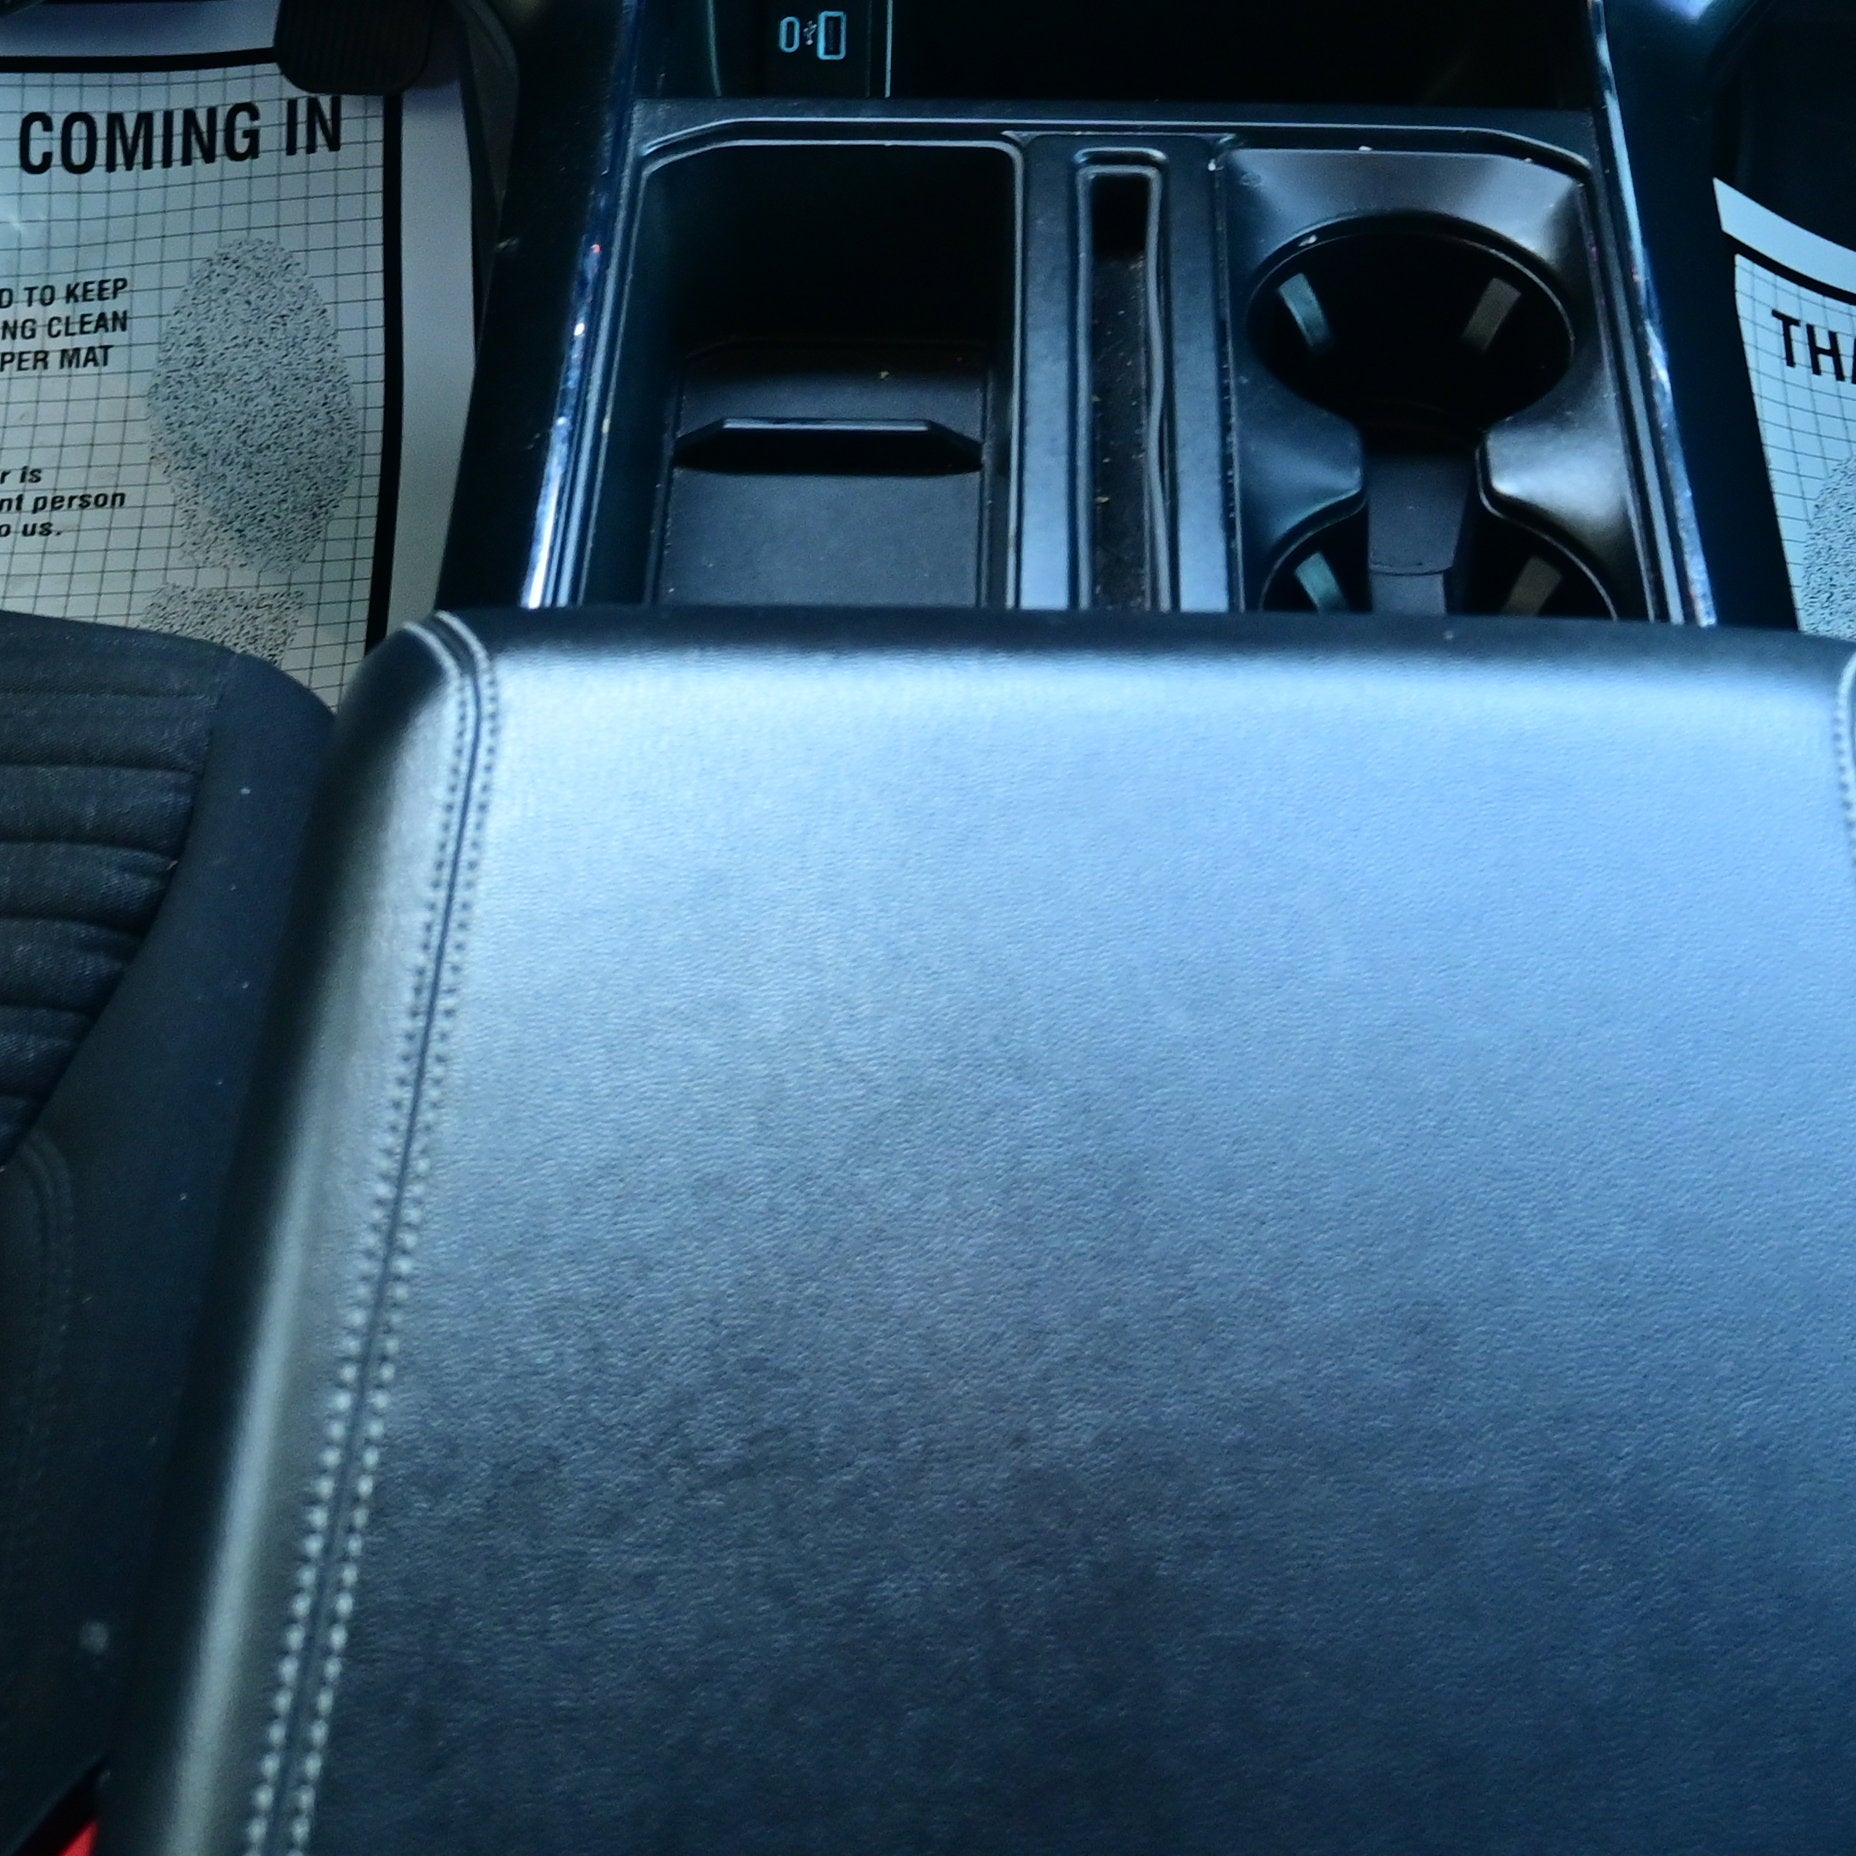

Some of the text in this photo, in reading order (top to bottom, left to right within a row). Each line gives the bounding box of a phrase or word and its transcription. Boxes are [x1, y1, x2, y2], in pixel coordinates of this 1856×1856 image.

[19, 100, 260, 175] COMING
[285, 95, 342, 156] IN
[24, 284, 55, 307] TO
[66, 278, 128, 303] KEEP
[47, 310, 128, 338] CLEAN
[59, 345, 114, 369] MAT
[19, 465, 42, 484] is
[32, 490, 126, 515] person
[22, 519, 62, 537] us.
